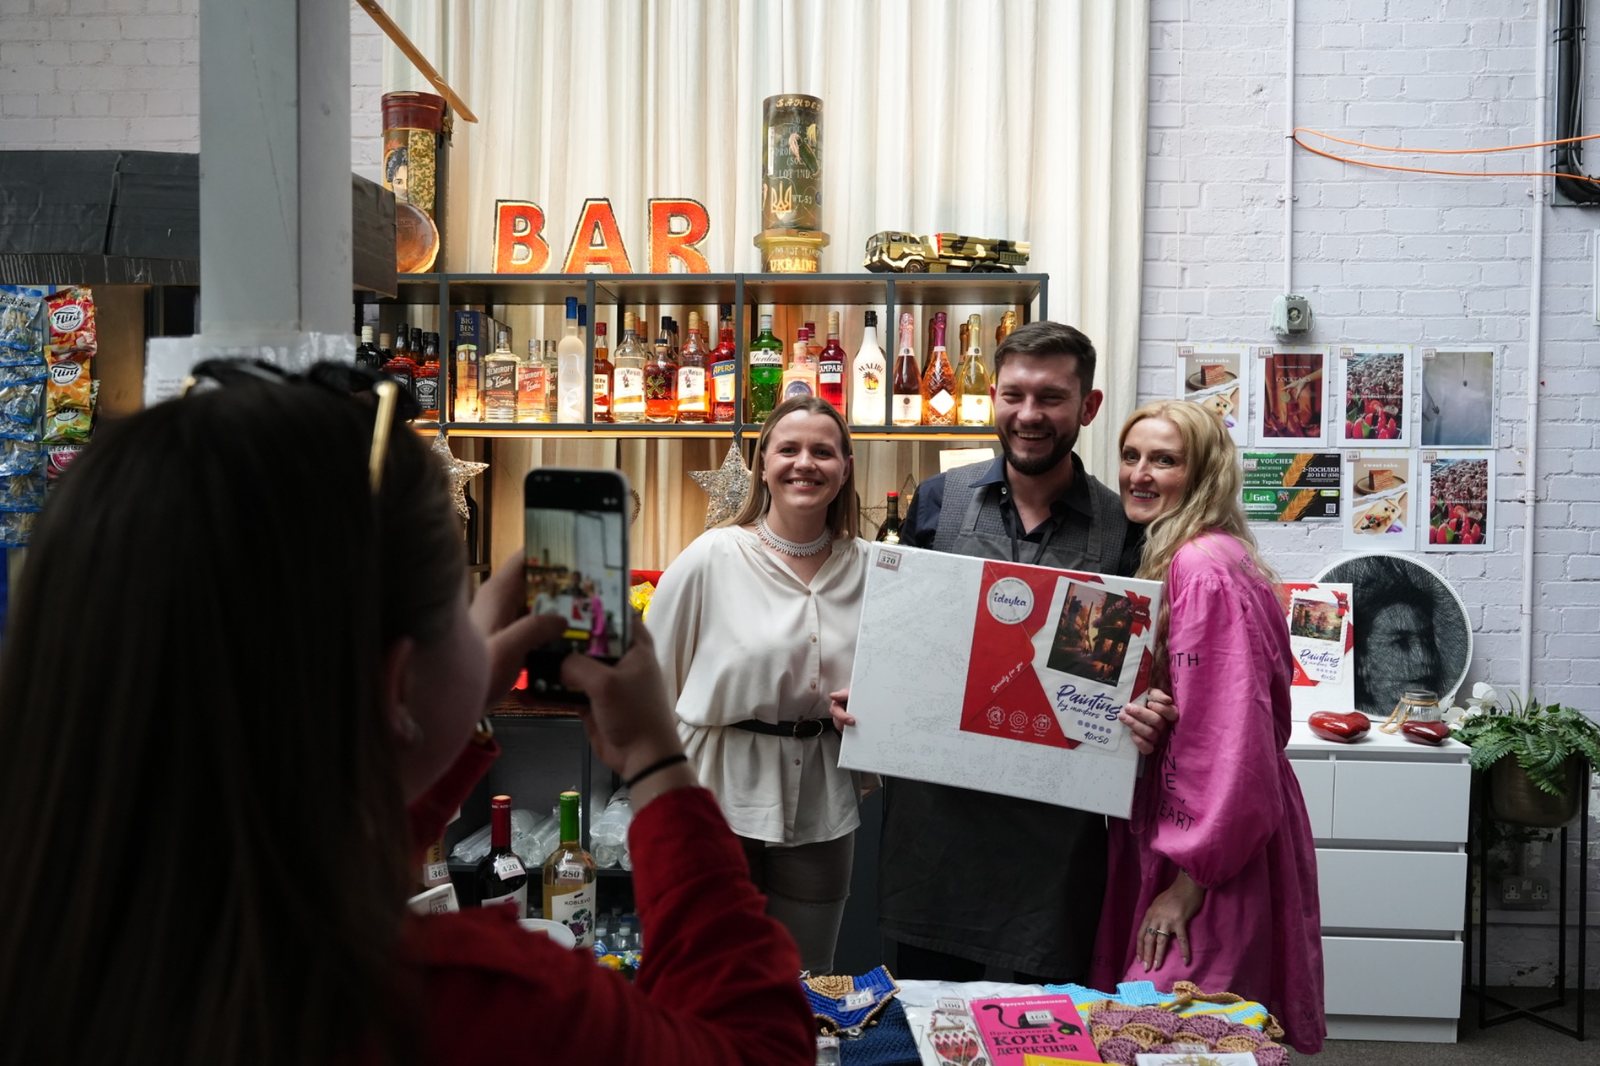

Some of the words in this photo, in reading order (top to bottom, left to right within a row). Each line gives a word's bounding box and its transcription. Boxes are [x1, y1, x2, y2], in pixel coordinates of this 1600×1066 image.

[493, 198, 709, 275] BAR
[770, 258, 817, 273] UKRAINE
[53, 310, 81, 326] Flint
[460, 317, 473, 325] BIG
[459, 324, 474, 332] BEN
[51, 364, 79, 379] Flint
[713, 364, 735, 376] APERO
[819, 364, 844, 373] AMPARI
[1170, 652, 1199, 667] ITH
[1299, 649, 1340, 667] Painting
[1056, 684, 1123, 720] Painting
[1056, 701, 1069, 713] by
[1159, 803, 1196, 832] EART
[431, 869, 449, 879] 365
[561, 870, 580, 879] 280
[563, 896, 592, 906] KOBLEVO
[992, 1033, 1066, 1047] кота-
[996, 1044, 1080, 1057] детектива
